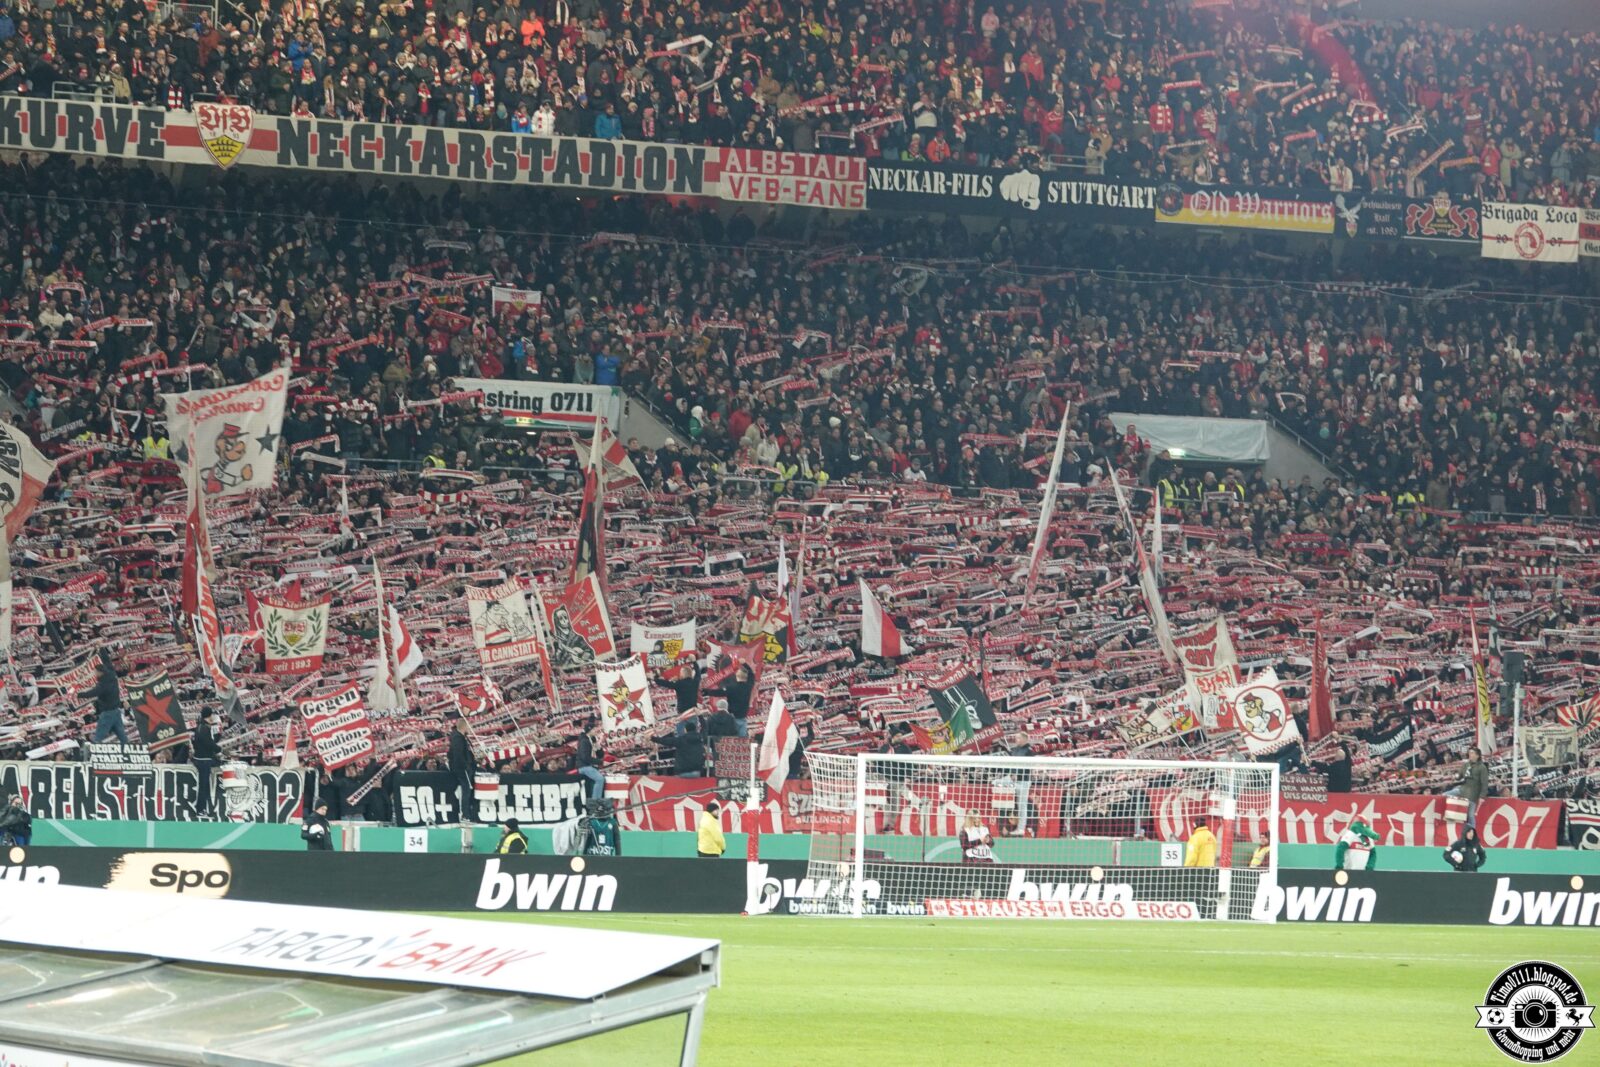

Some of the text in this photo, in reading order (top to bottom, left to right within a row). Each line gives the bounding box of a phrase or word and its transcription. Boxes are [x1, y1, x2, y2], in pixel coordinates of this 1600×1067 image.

[277, 118, 705, 194] NECKARSTADION
[725, 151, 866, 181] ALBSTADT
[728, 174, 864, 208] VFB-FANS
[869, 167, 993, 199] NECKAR-FILS
[1048, 181, 1156, 209] STUTTGART
[1190, 190, 1229, 218] Old
[1482, 203, 1538, 224] Brigada
[551, 392, 593, 412] 0711
[303, 690, 357, 716] Gegen
[90, 743, 149, 754] GEGEN ALLE
[318, 730, 367, 751] Stadion-
[324, 742, 369, 762] verbote
[130, 754, 151, 763] UND
[1484, 803, 1551, 850] 97
[409, 836, 423, 846] 34
[0, 847, 60, 885] in
[1165, 850, 1178, 860] 35
[150, 863, 229, 892] Spo
[477, 857, 617, 911] bwin
[1007, 866, 1134, 902] bwin
[887, 900, 925, 915] bwin
[1250, 870, 1377, 923] bwin
[1071, 902, 1124, 918] ERGO
[1137, 902, 1192, 918] ERGO
